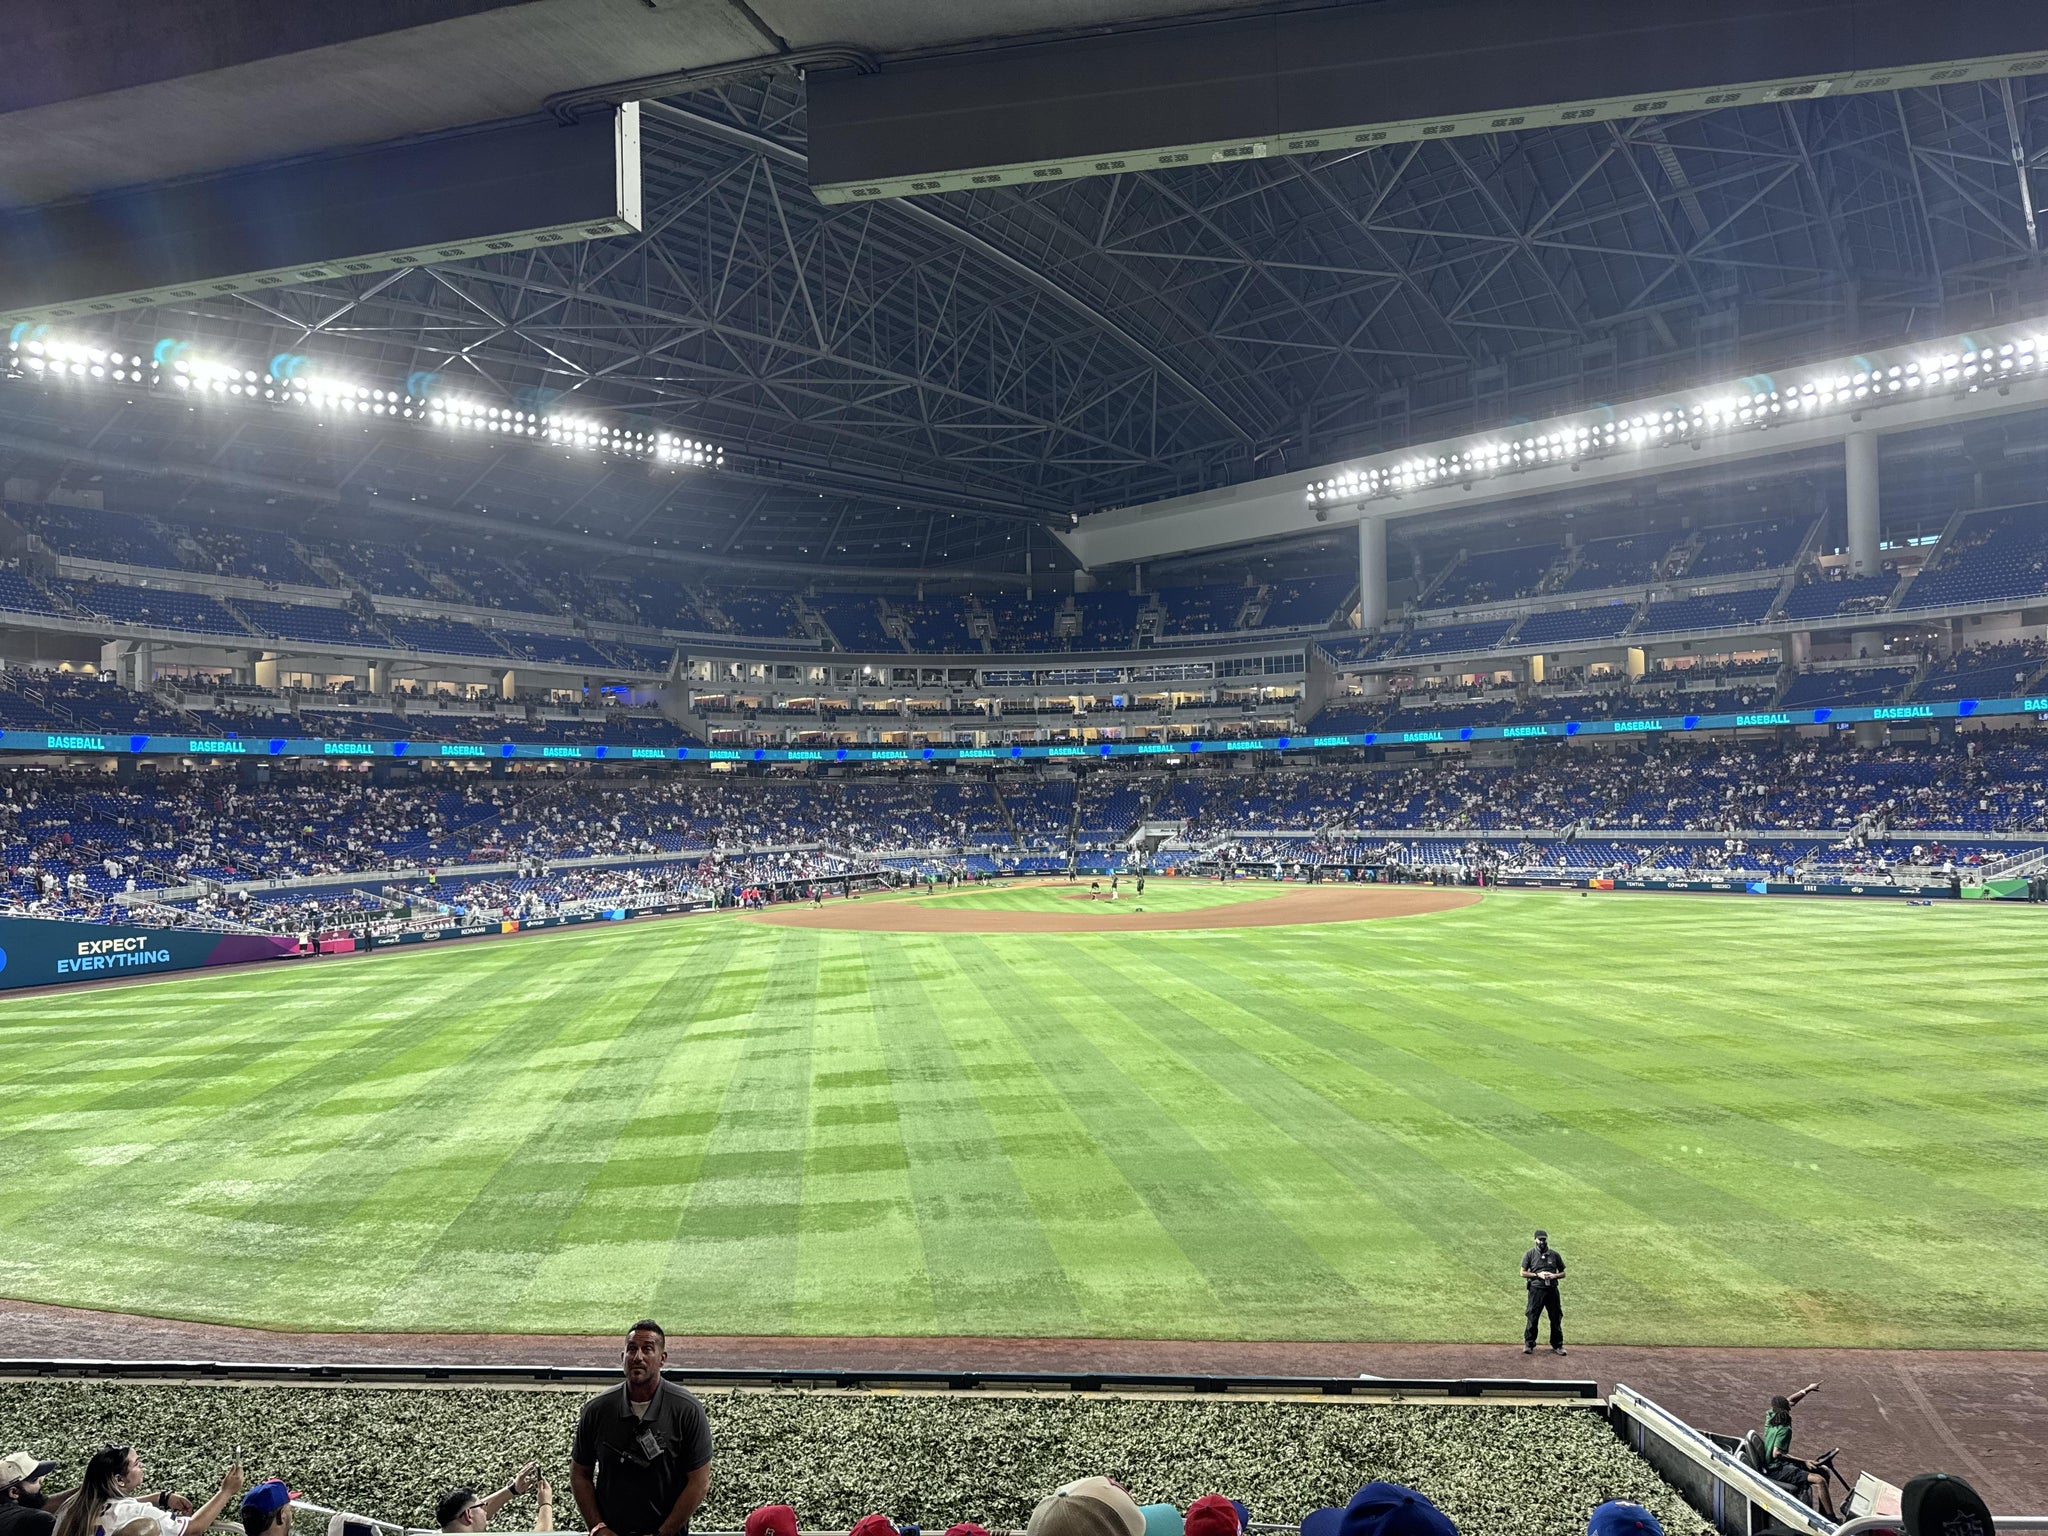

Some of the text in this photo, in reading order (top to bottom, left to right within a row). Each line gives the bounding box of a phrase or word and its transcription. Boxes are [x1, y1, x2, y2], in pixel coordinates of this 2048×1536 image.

[1874, 708, 1934, 720] BASEBALL
[1736, 714, 1790, 726] BASEBALL
[1614, 720, 1662, 732] BASEBALL
[1404, 732, 1442, 742] BASEBALL
[1504, 726, 1548, 738] BASEBALL
[48, 736, 104, 750] BASEBALL
[190, 740, 244, 752] BASEBALL
[1228, 742, 1262, 750] BASEBALL
[1314, 736, 1350, 746] BASEBALL
[324, 744, 372, 754] BASEBALL
[441, 746, 484, 756] BASEBALL
[544, 748, 582, 758] BASEBALL
[632, 748, 664, 758] BASEBALL
[959, 750, 996, 758] BASEBALL
[1049, 748, 1086, 756] BASEBALL
[1138, 744, 1174, 754] BASEBALL
[709, 750, 740, 760] BASEBALL
[788, 750, 822, 760] BASEBALL
[872, 750, 908, 760] BASEBALL
[461, 927, 486, 935] KONAMI
[78, 936, 147, 955] EXPECT
[57, 949, 170, 973] EVERYTHING
